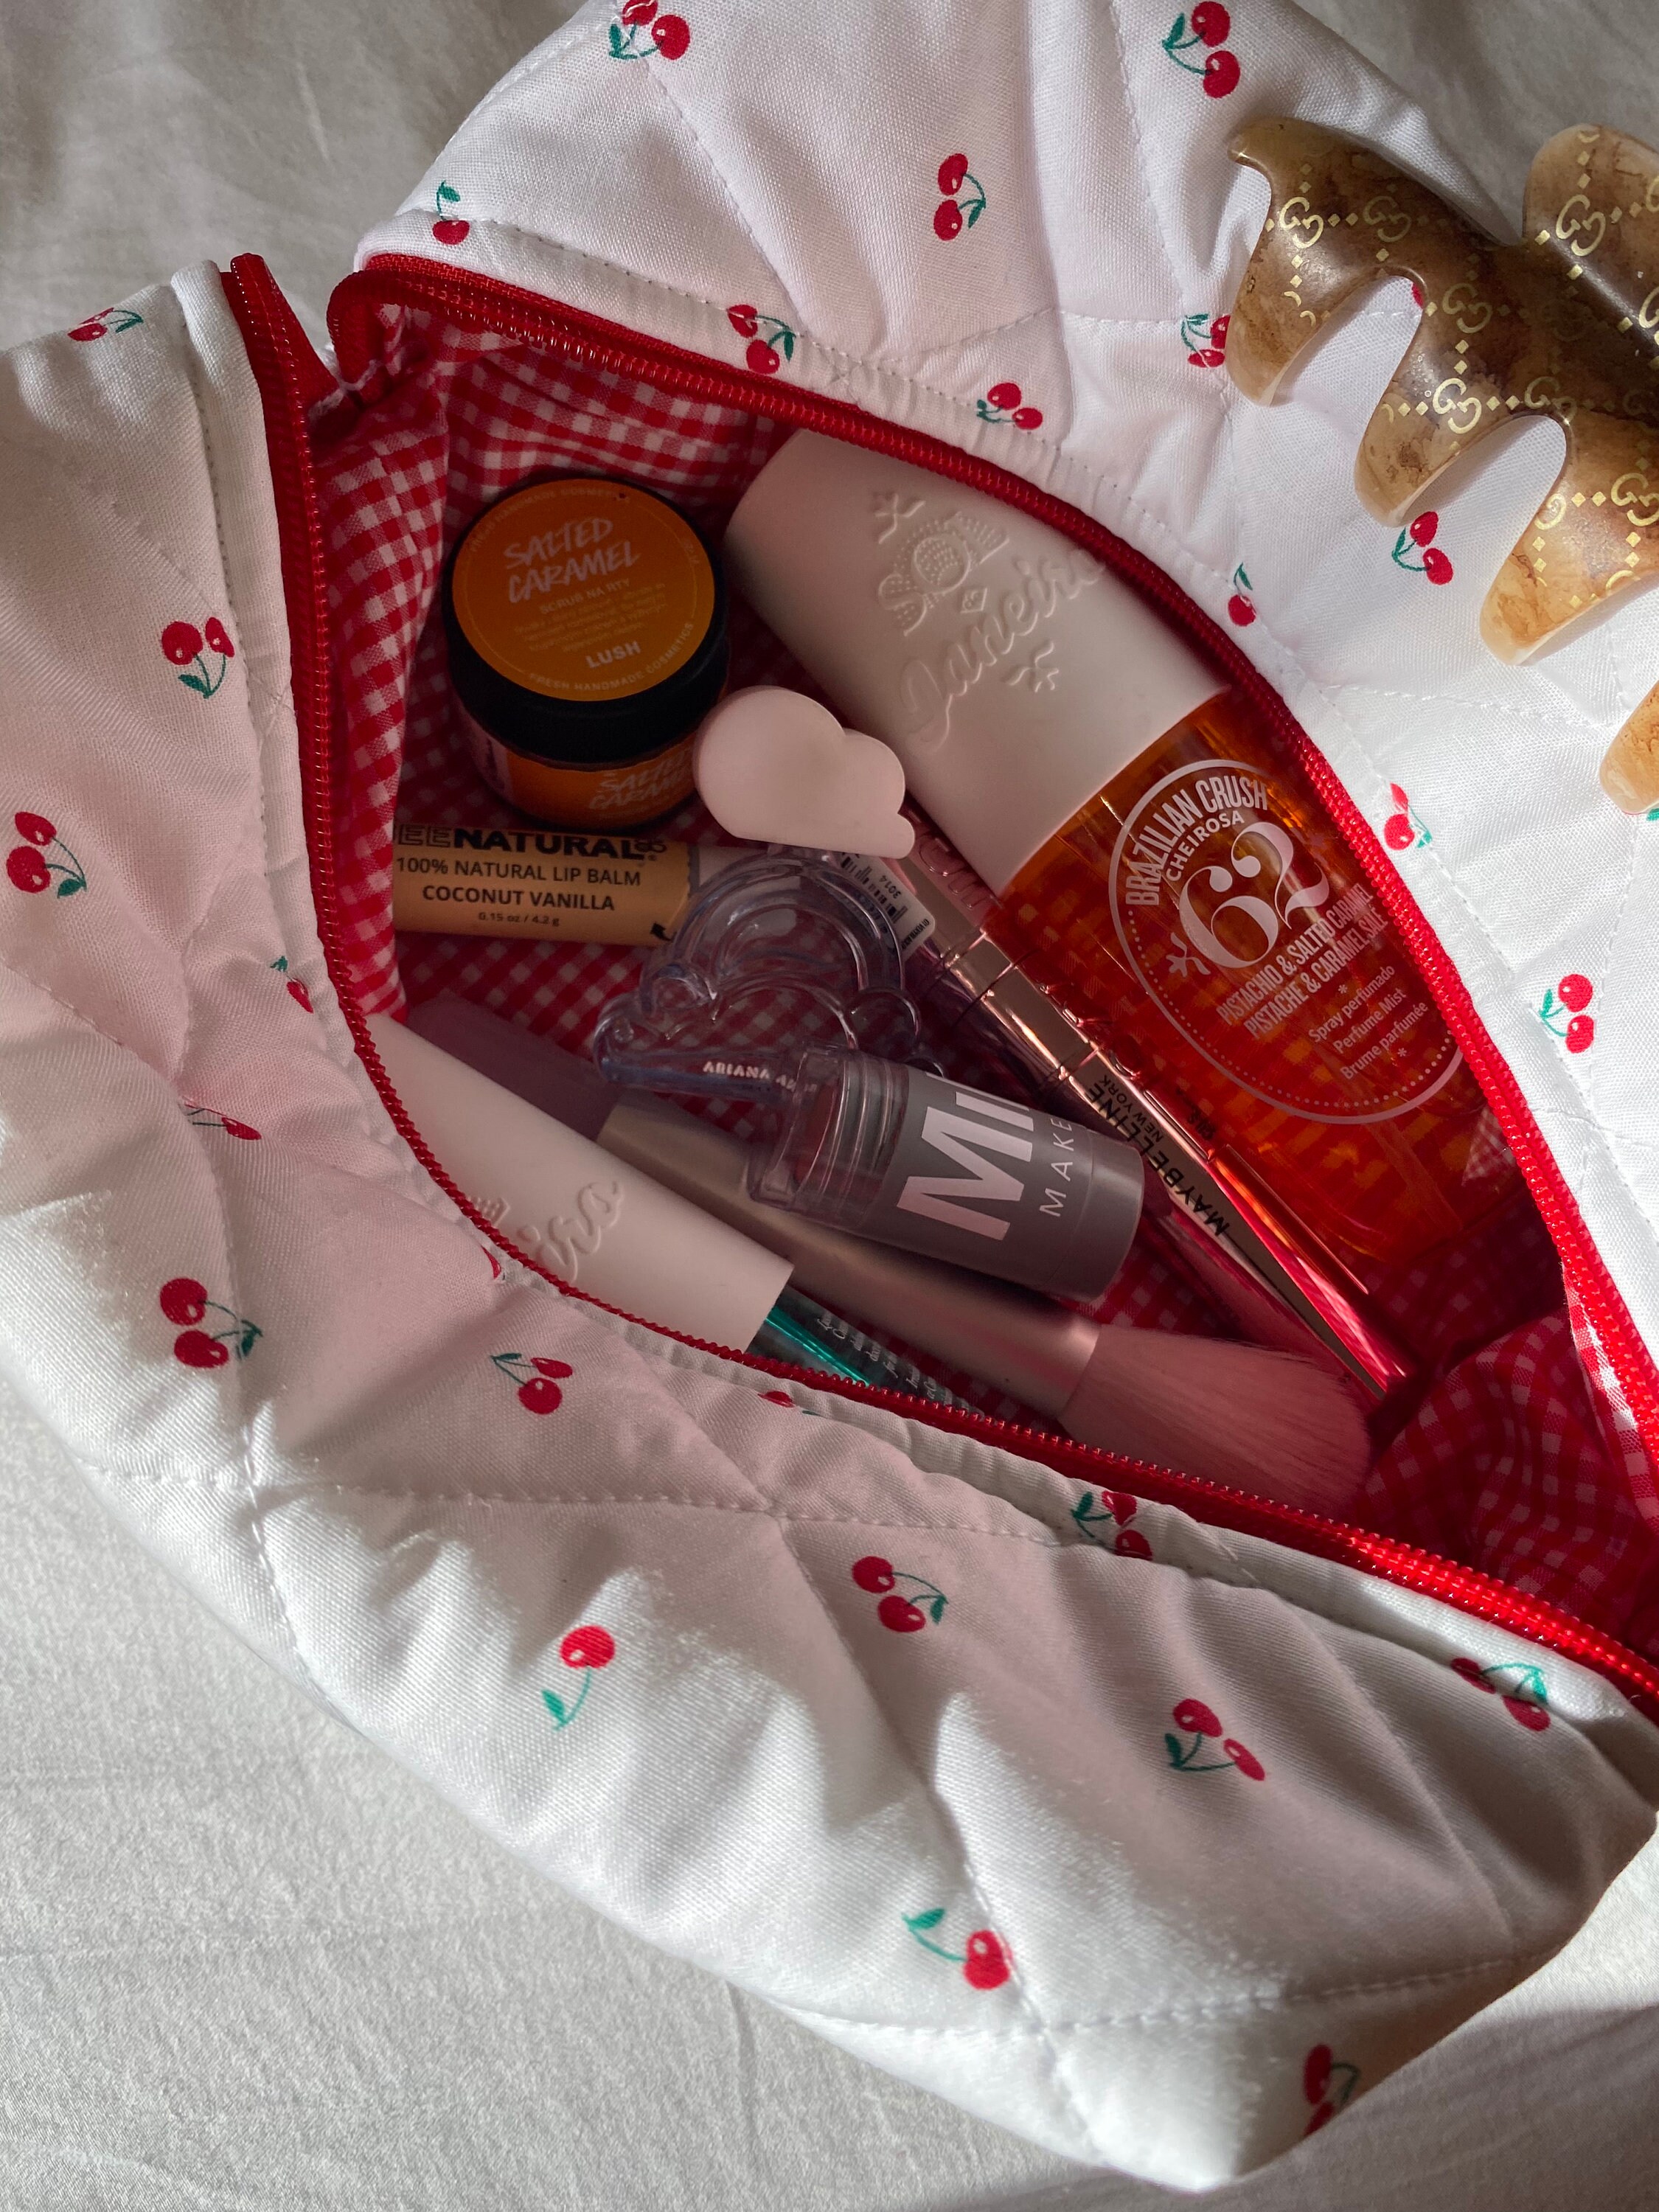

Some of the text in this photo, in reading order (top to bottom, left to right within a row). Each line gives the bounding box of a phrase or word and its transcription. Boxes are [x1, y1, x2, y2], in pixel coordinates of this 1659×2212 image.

[503, 517, 613, 569] SALTED
[508, 541, 641, 603] CARAMEL
[540, 592, 583, 614] SCRUB
[529, 623, 694, 691] FRESH HANDMADE COSMETICS
[585, 640, 641, 668] LUSH
[396, 857, 641, 886] 100% NATURAL LIP BALM
[1126, 776, 1268, 905] BRAZILIAN CRUSH
[1166, 810, 1244, 882] CHEIROSA
[422, 886, 615, 911] COCONUT VANILLA
[479, 911, 503, 922] 0.15
[507, 915, 520, 923] oz
[532, 915, 550, 925] 4.2
[552, 917, 560, 927] g
[1179, 822, 1329, 969] 62
[1215, 883, 1374, 1026] PISTACHIO & SALTED CARAMEL
[1243, 986, 1309, 1039] PISTACHE
[1306, 972, 1321, 992] &
[1314, 933, 1368, 984] CARAMEL
[1308, 964, 1395, 1042] Spray perfumado
[1333, 987, 1407, 1054] Perfume Mist
[703, 1061, 770, 1079] ARIANA
[1340, 1001, 1428, 1080] Brume parfumée
[1100, 1074, 1163, 1142] NEW YORK
[1040, 1118, 1074, 1217] MAKE
[1085, 1082, 1230, 1237] MAYBELLINE
